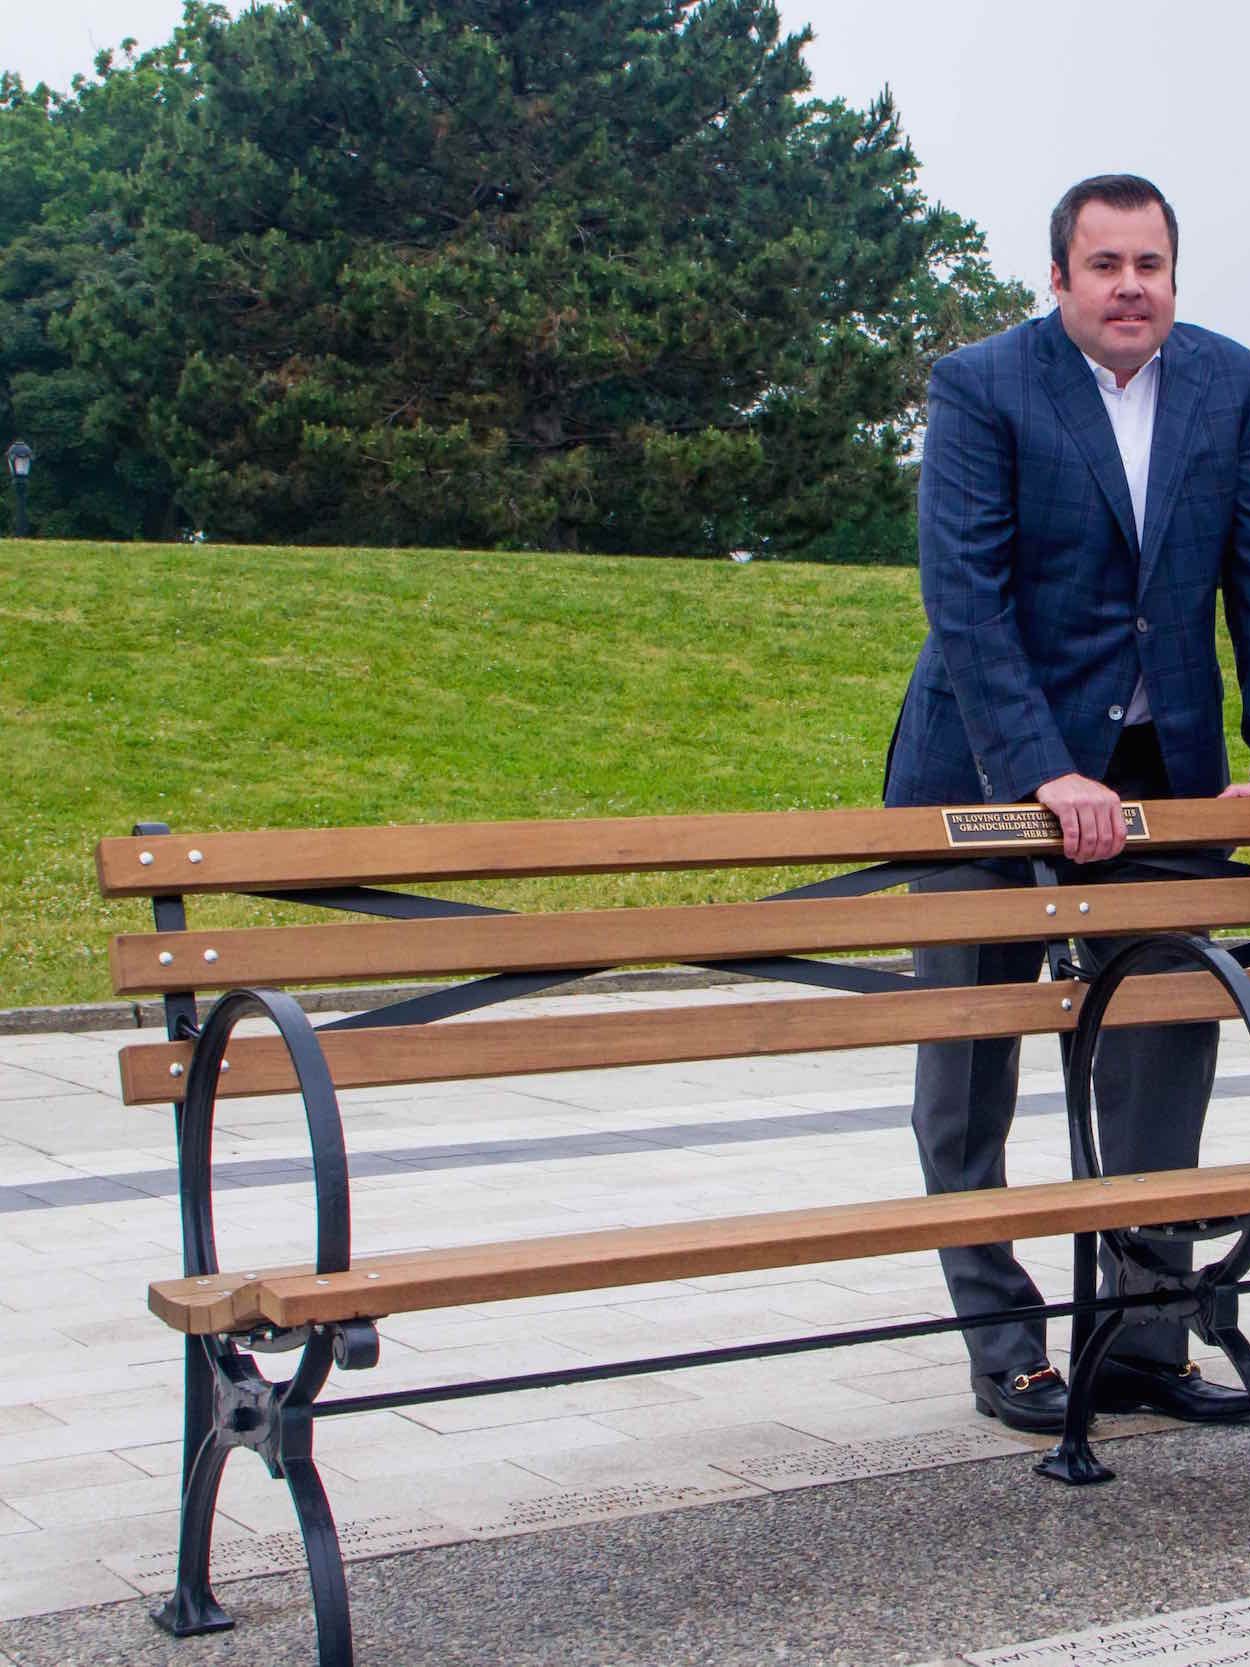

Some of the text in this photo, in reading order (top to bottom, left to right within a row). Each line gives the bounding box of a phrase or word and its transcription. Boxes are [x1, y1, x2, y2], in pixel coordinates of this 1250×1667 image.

[951, 814, 963, 824] IN
[965, 812, 1001, 823] LOVING
[959, 821, 1040, 833] GRANDCHILDREN
[984, 1641, 1083, 1666] WILLIAM
